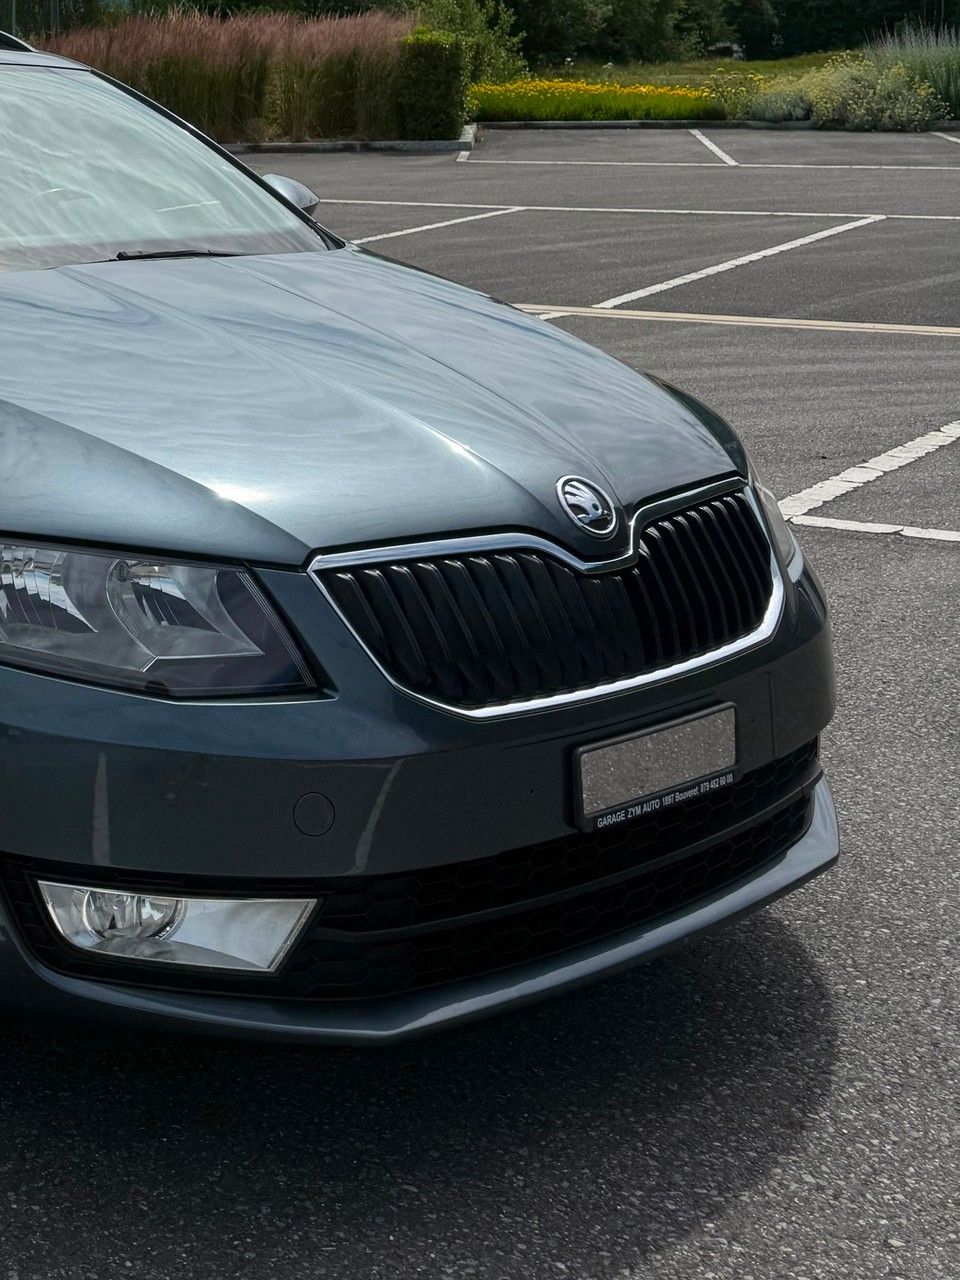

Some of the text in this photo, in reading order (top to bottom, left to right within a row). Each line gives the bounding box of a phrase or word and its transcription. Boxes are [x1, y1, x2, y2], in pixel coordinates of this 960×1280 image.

[597, 811, 626, 828] GARAGE
[627, 803, 641, 819] ZYM
[642, 798, 660, 813] AUTO
[661, 793, 675, 809] 1897
[675, 786, 699, 802] Bouveret
